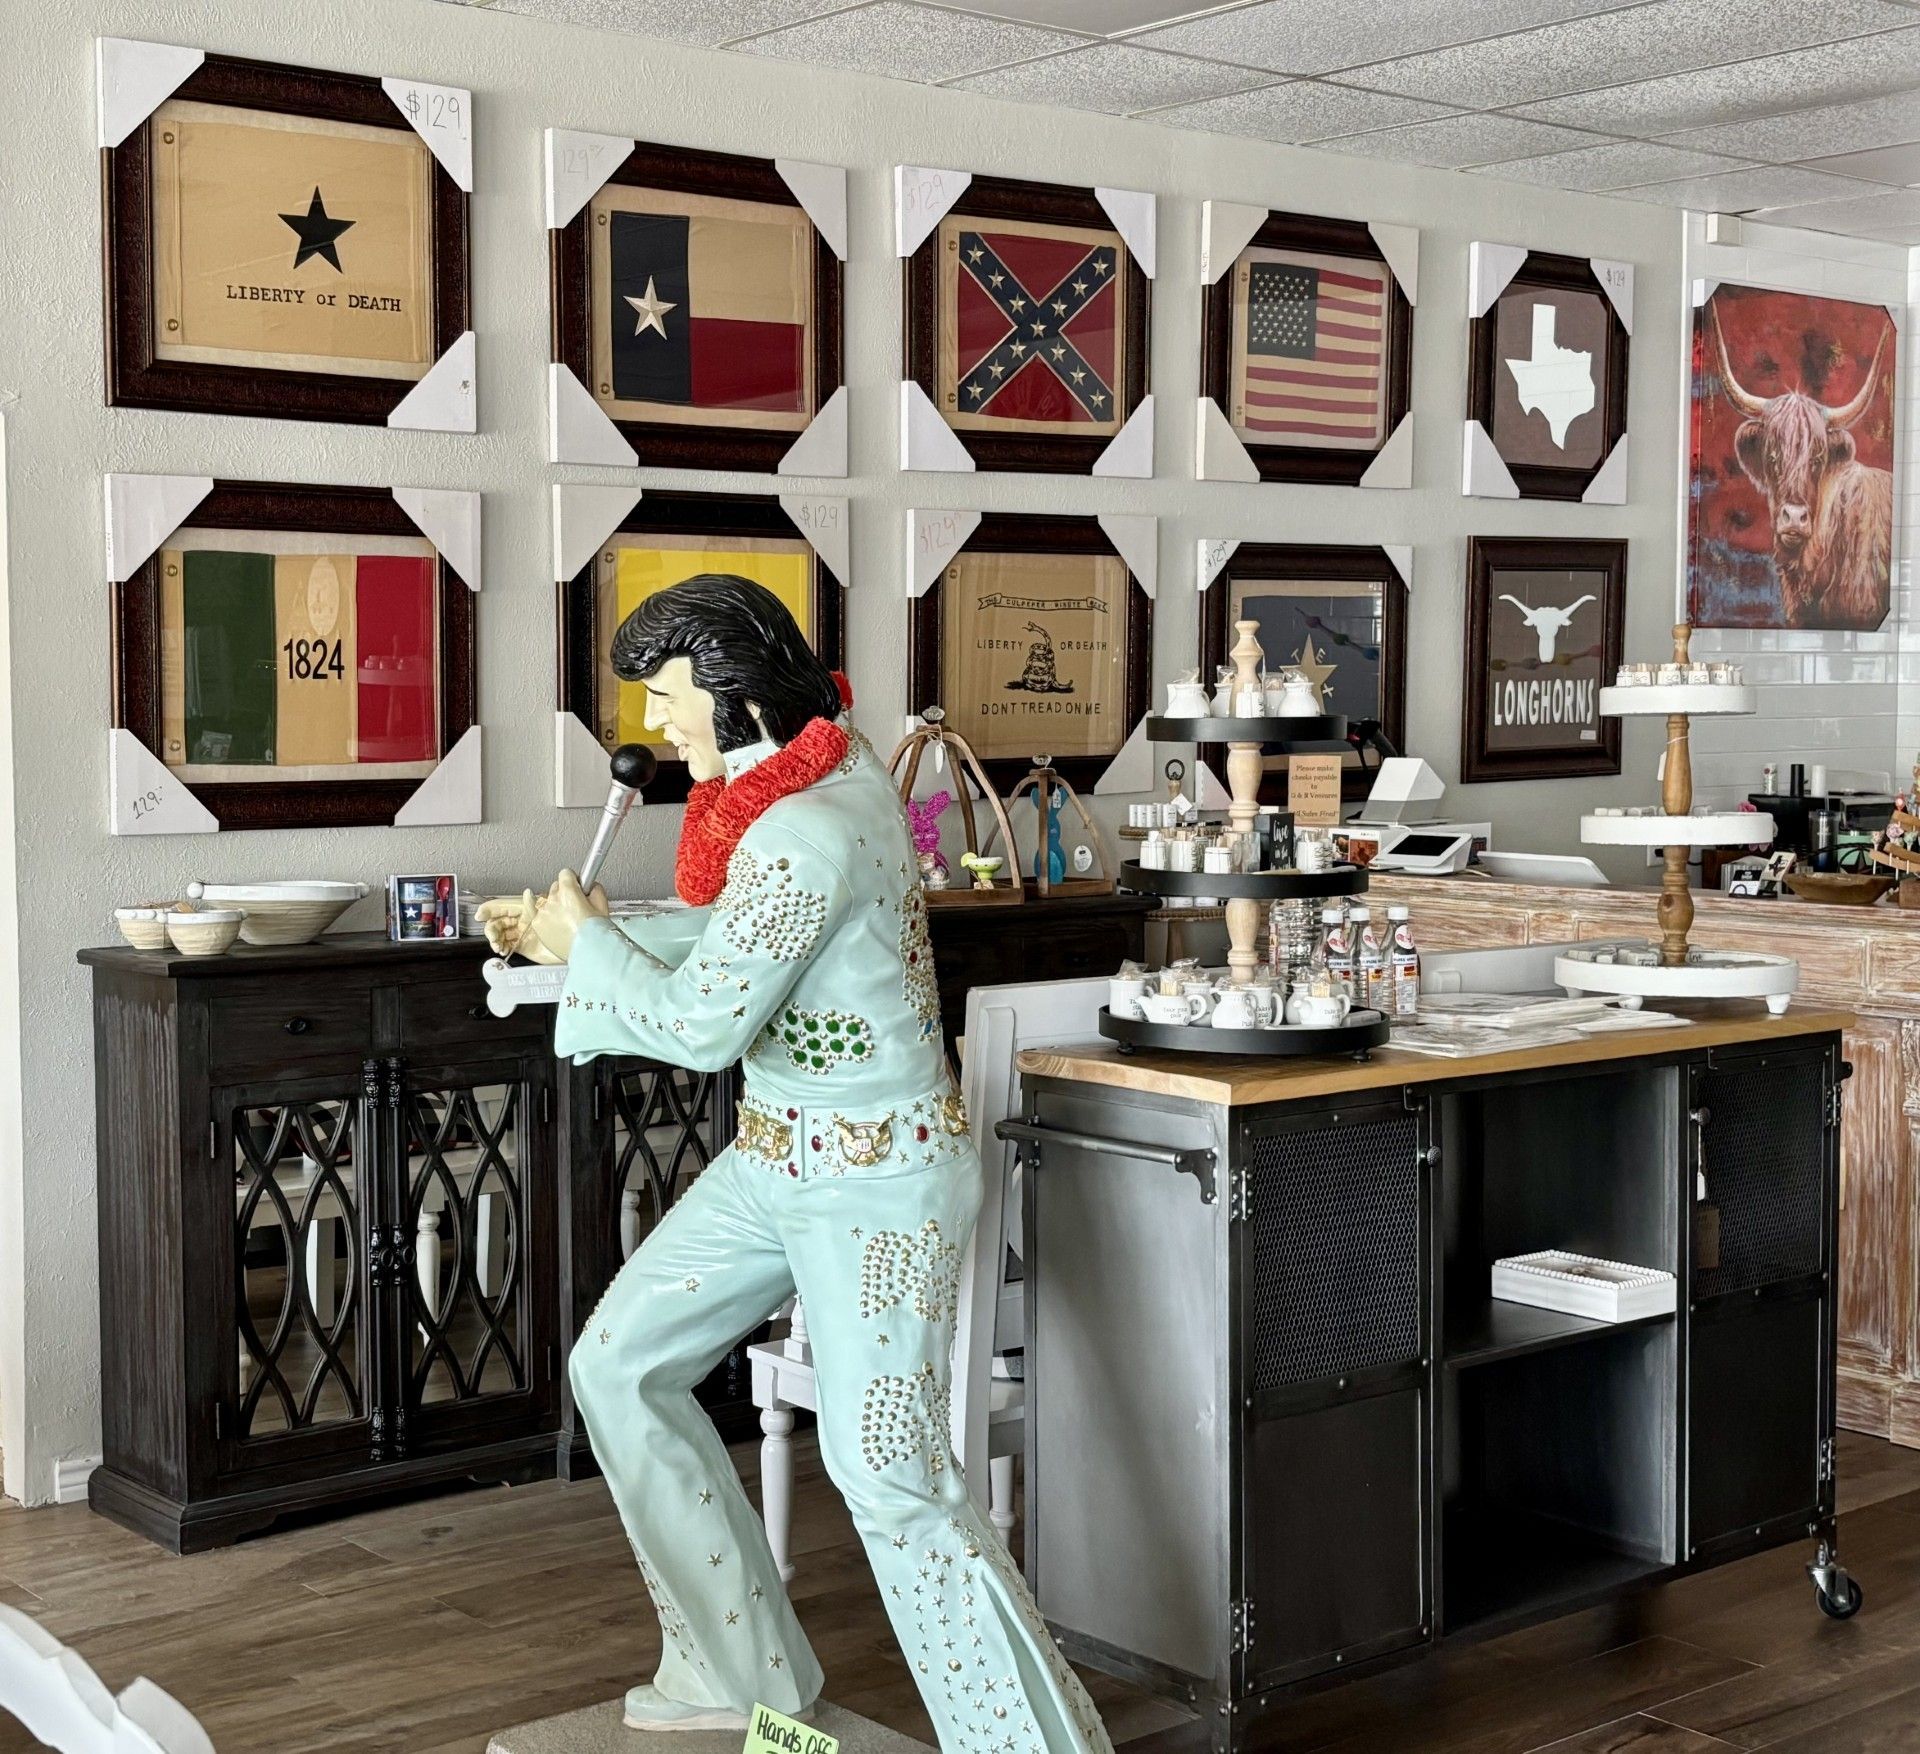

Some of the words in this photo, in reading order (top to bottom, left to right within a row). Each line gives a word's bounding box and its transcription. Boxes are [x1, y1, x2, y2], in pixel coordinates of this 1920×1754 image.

[404, 89, 460, 130] $129
[226, 285, 306, 304] LIBERTY
[316, 293, 337, 306] or
[348, 294, 402, 312] DEATH
[799, 502, 838, 532] $129
[283, 638, 345, 680] 1824
[976, 639, 1024, 651] LIBERTY
[1060, 640, 1074, 651] OR
[1075, 641, 1108, 651] DEATH
[981, 702, 1018, 715] DONT
[1021, 701, 1062, 715] TREAD
[1065, 702, 1081, 715] ON
[1085, 702, 1102, 715] ME
[1494, 678, 1595, 727] LONGHORNS
[756, 1710, 802, 1753] Hands
